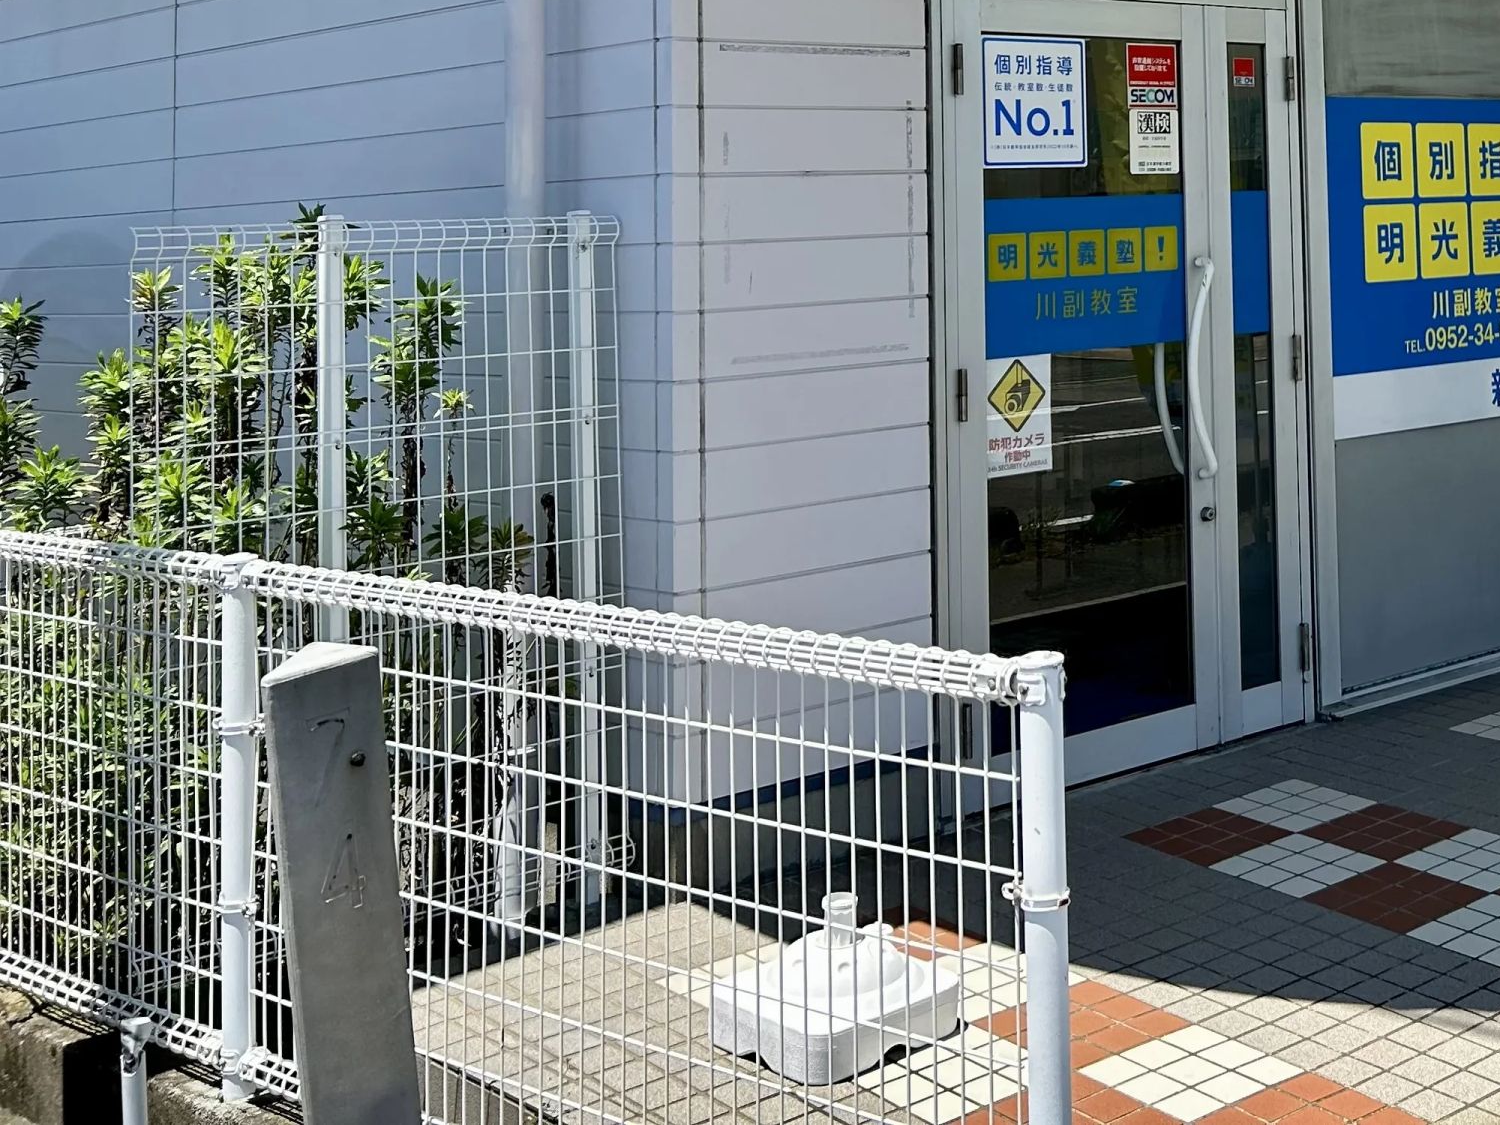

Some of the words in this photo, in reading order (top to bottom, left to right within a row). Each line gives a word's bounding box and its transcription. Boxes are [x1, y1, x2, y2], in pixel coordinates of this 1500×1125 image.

[994, 54, 1073, 76] 個別指導
[1131, 88, 1175, 104] SECOM
[994, 98, 1075, 137] No.1
[1137, 111, 1171, 134] 漢検
[998, 235, 1166, 270] 明光義塾!
[1035, 288, 1138, 321] 川副教室
[988, 433, 1045, 452] 防犯カメラ
[1004, 449, 1031, 463] 作動中
